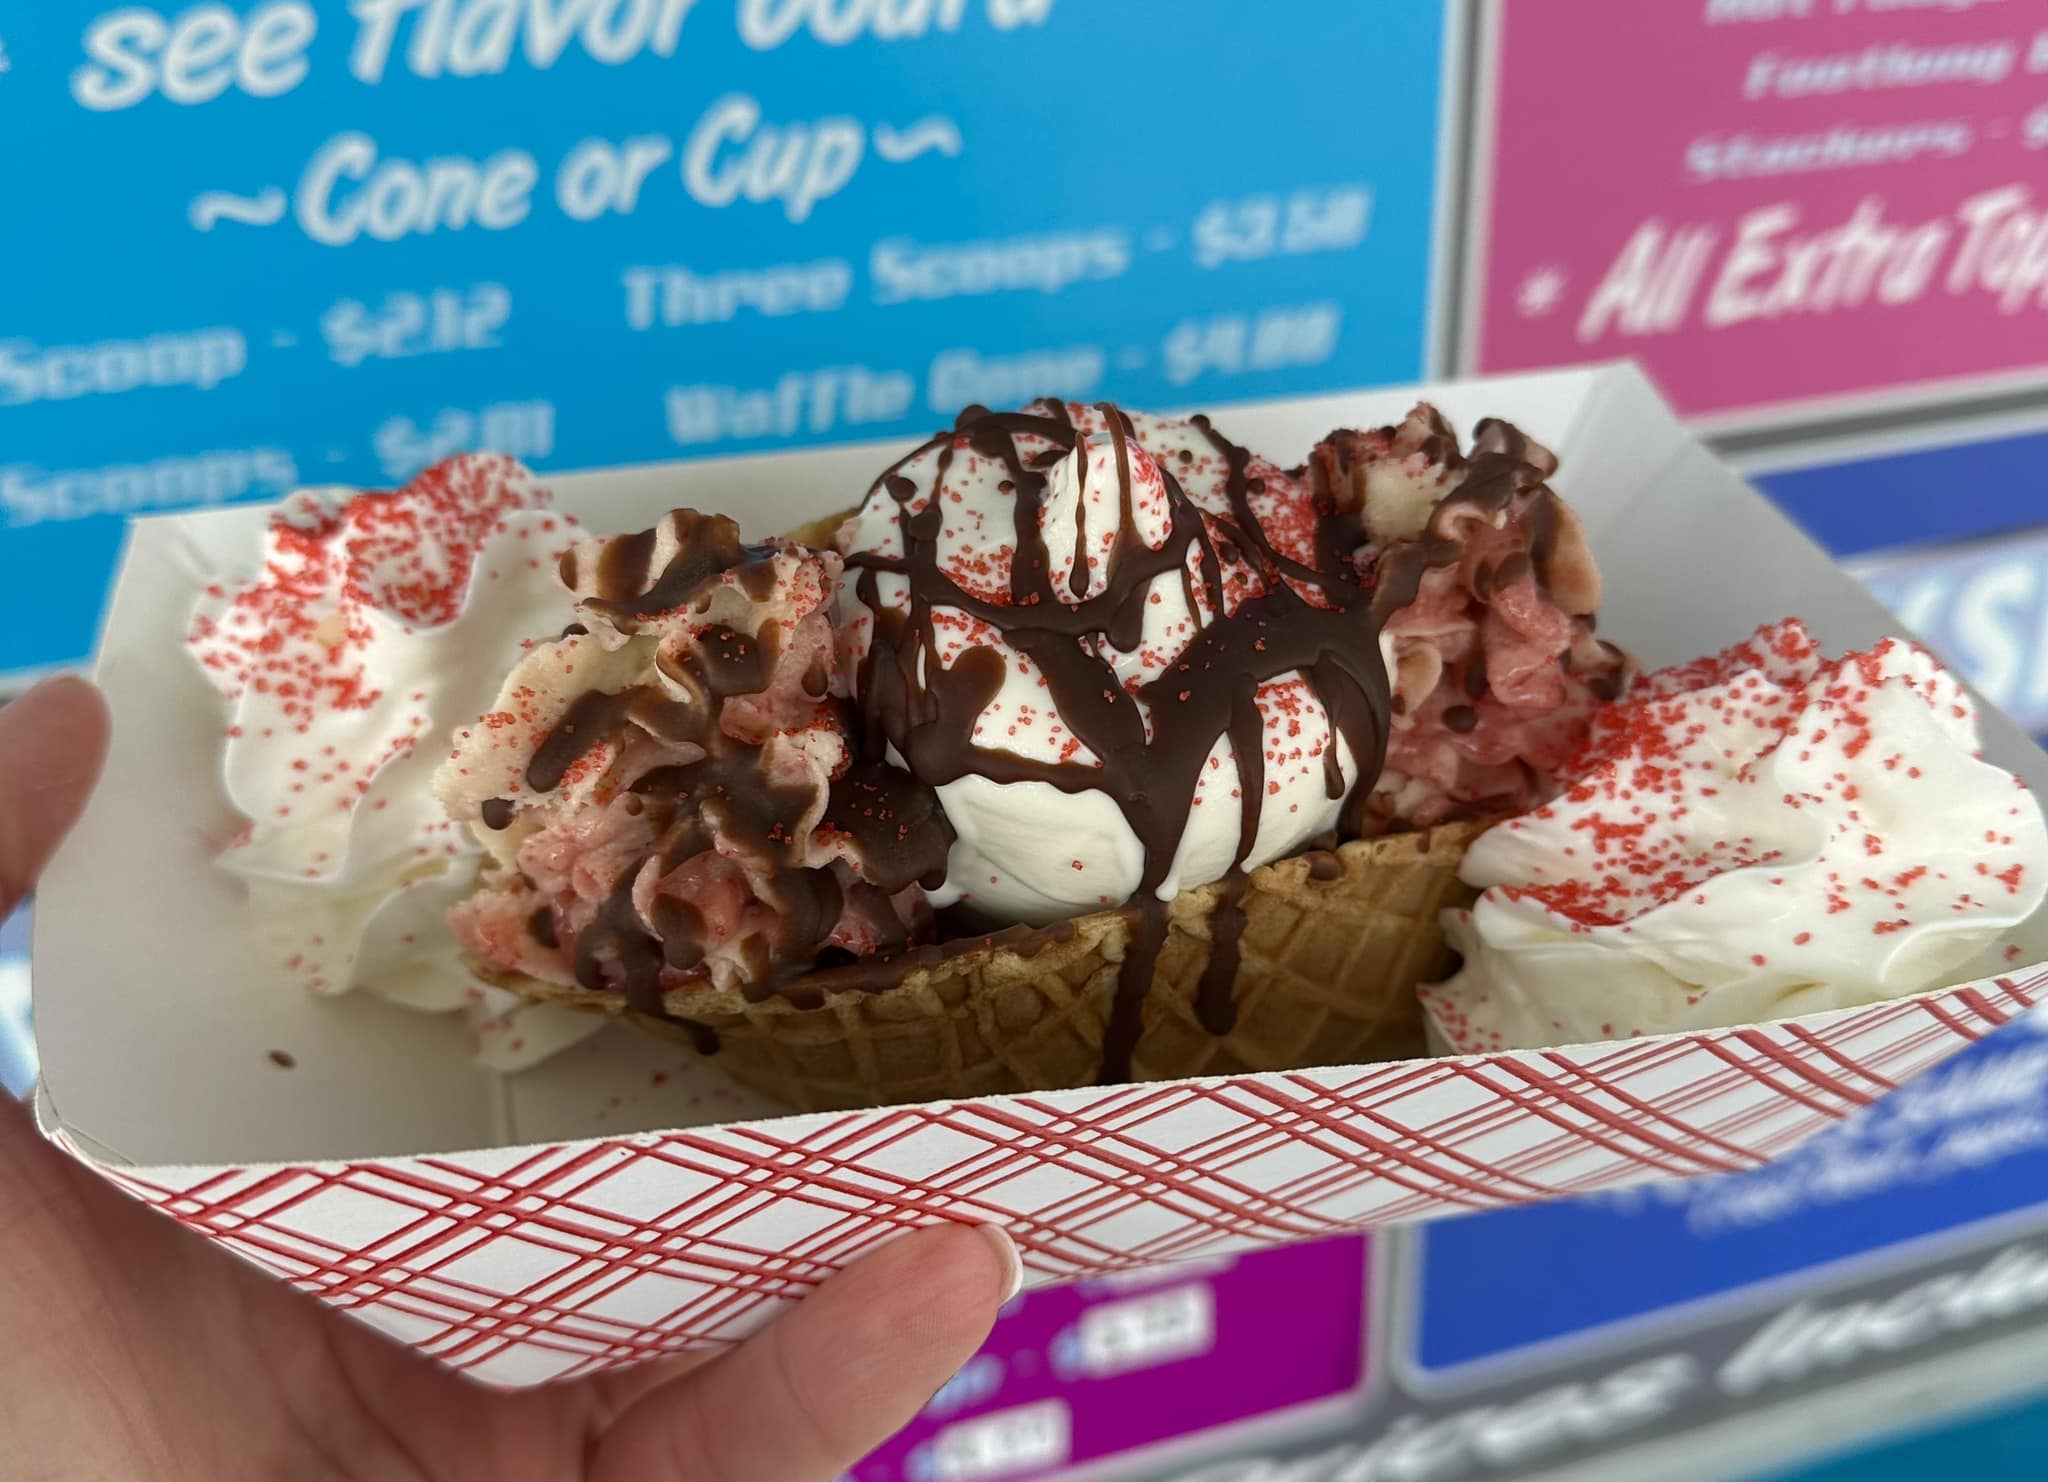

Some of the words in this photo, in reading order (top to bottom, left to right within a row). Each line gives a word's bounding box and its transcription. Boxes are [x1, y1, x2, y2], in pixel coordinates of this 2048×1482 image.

[72, 3, 317, 110] see
[350, 0, 696, 84] flavor
[557, 137, 671, 220] or
[625, 262, 851, 330] Three
[872, 228, 1131, 302] Scoops
[1576, 215, 1720, 344] All
[1704, 195, 1950, 330] Extra
[1946, 183, 2048, 318] Top
[0, 330, 245, 404] Scoop
[667, 364, 915, 446] Waffle
